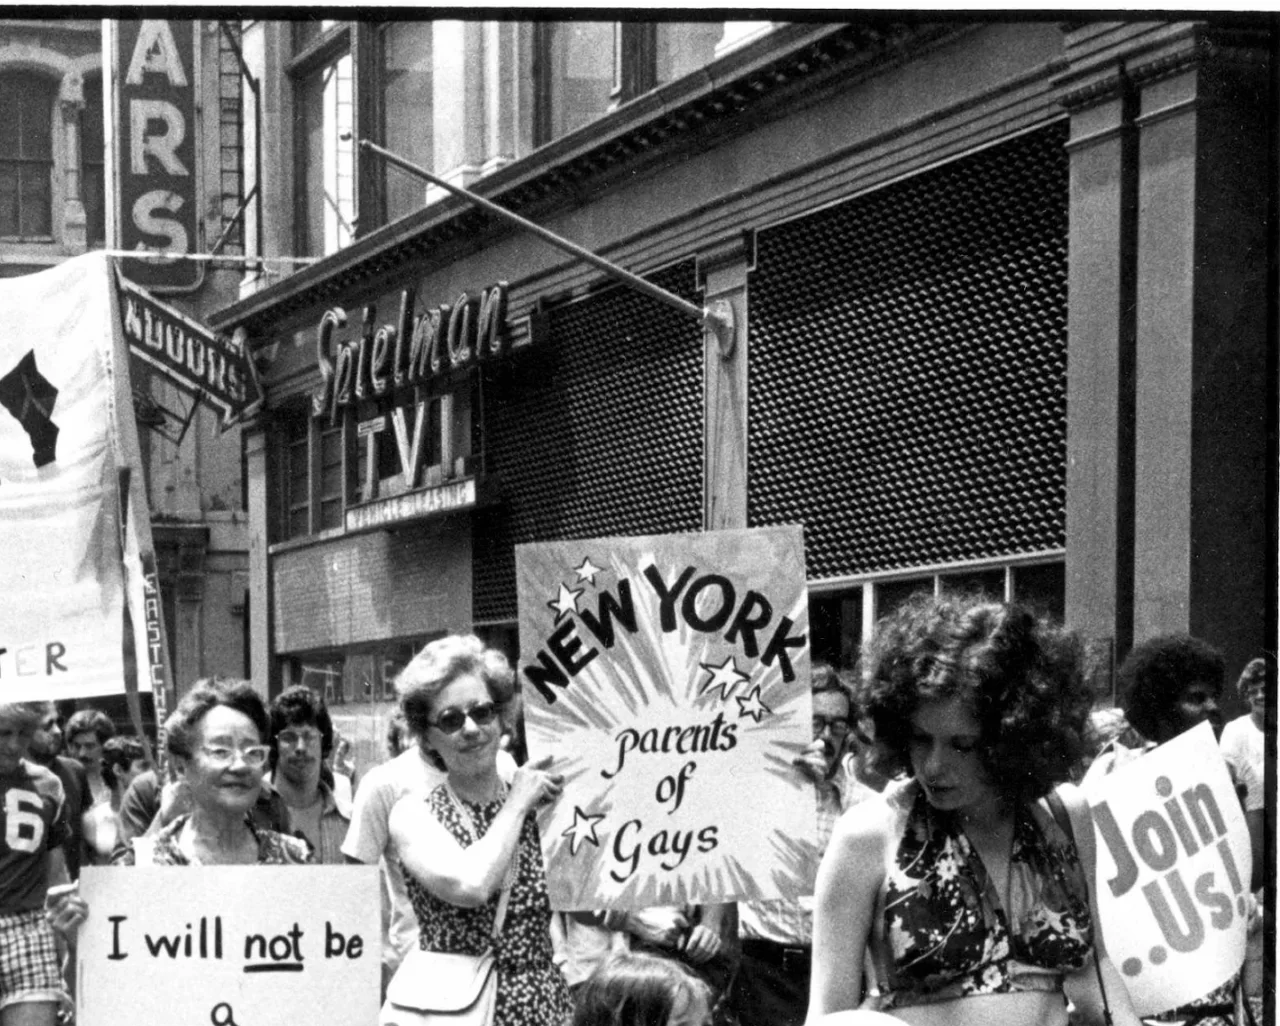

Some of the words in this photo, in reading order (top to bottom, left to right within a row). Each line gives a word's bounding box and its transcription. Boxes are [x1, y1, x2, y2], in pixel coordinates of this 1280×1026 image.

[312, 286, 503, 426] Spielman
[524, 578, 639, 704] NEW
[643, 564, 806, 683] YORK
[601, 712, 737, 779] parents
[655, 761, 697, 815] of
[610, 819, 719, 883] Gays
[1092, 775, 1228, 898] Join
[107, 915, 128, 961] I
[144, 915, 223, 960] will
[244, 922, 305, 963] not
[325, 921, 364, 960] be
